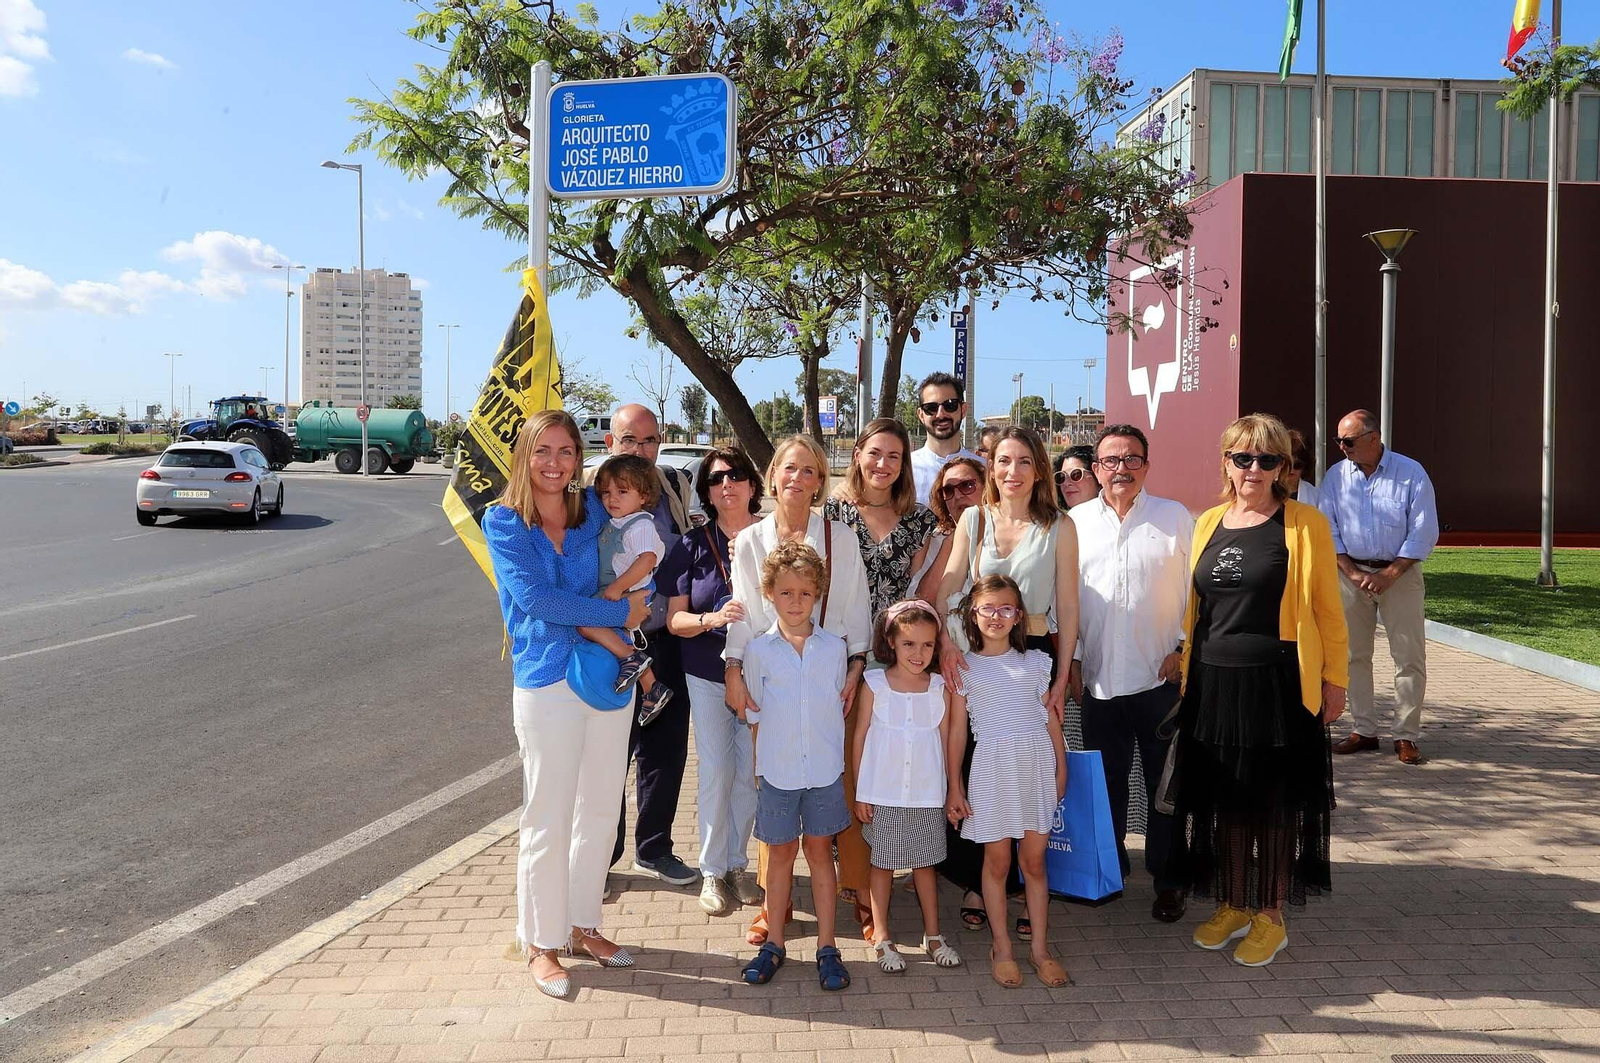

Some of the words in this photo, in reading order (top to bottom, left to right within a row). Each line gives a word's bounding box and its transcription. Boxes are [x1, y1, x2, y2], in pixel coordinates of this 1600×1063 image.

[562, 114, 605, 124] GLORIETA
[561, 123, 650, 146] ARQUITECTO
[561, 144, 597, 166] JOSÉ
[602, 145, 649, 165] PABLO
[561, 165, 625, 188] VÁZQUEZ
[629, 165, 683, 185] HIERRO
[953, 313, 965, 326] P
[1193, 299, 1201, 352] Hermida
[957, 331, 965, 380] PARKIN
[1187, 353, 1193, 371] LA
[1186, 374, 1192, 392] DE
[479, 375, 527, 454] FOYES
[827, 400, 834, 410] P
[1047, 841, 1072, 852] UELVA
